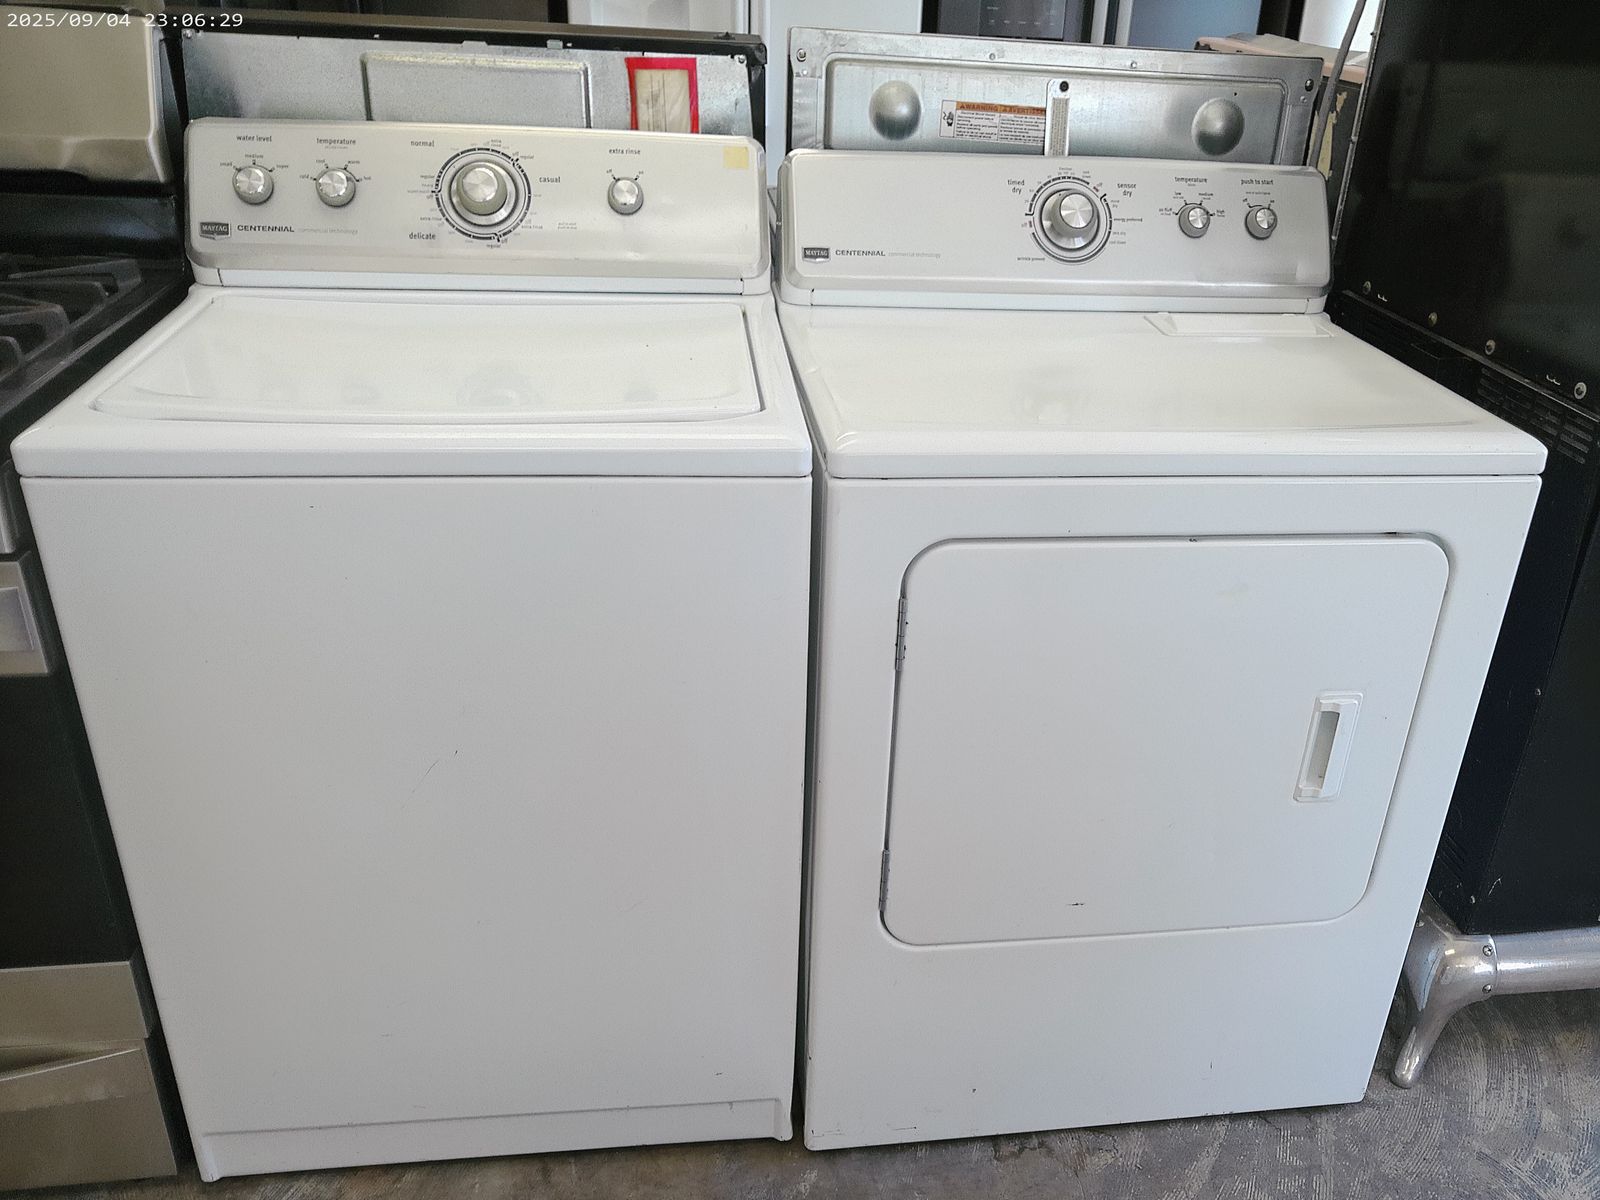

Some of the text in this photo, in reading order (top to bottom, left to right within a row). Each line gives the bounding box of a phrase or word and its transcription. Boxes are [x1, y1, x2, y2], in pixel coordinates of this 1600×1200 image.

[236, 134, 255, 142] water
[316, 137, 356, 145] temperature
[1174, 176, 1208, 184] temperature
[1240, 178, 1254, 186] push
[1011, 187, 1022, 195] dry
[202, 224, 229, 232] MAYTAG
[237, 224, 295, 233] CENTENNIAL
[408, 231, 436, 240] delicate
[804, 249, 828, 257] MAYTAG
[835, 249, 886, 257] CENTENNIAL
